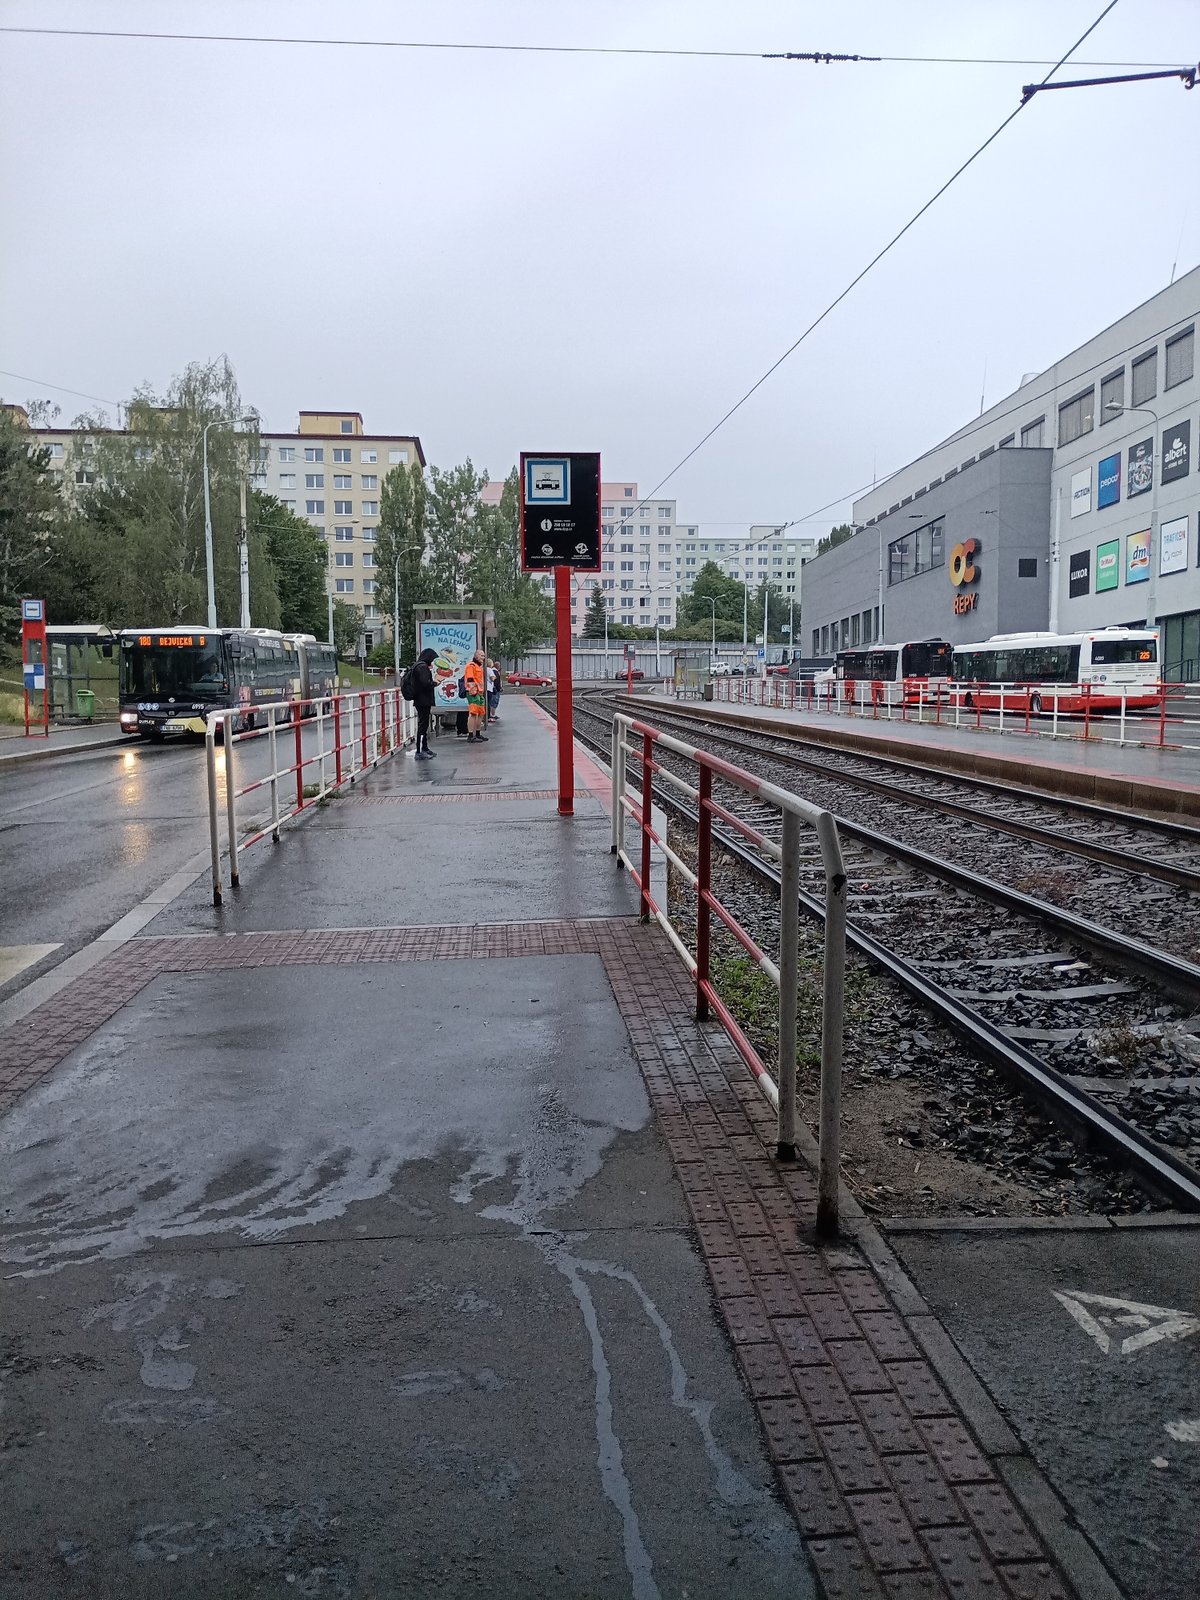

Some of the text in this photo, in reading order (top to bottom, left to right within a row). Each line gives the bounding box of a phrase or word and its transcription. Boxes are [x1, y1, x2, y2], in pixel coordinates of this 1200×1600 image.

[1164, 443, 1187, 463] albert
[1100, 473, 1119, 488] pepco
[1073, 487, 1090, 500] ACTION
[1132, 545, 1147, 560] dm
[949, 537, 976, 587] OC
[1070, 568, 1088, 580] LUXOR
[953, 592, 976, 616] ŘEPY
[139, 636, 151, 646] 180
[159, 636, 193, 646] DEJVICKÁ
[424, 627, 473, 642] SNACKUJ
[449, 639, 471, 651] LEHKO
[1139, 651, 1150, 660] 225
